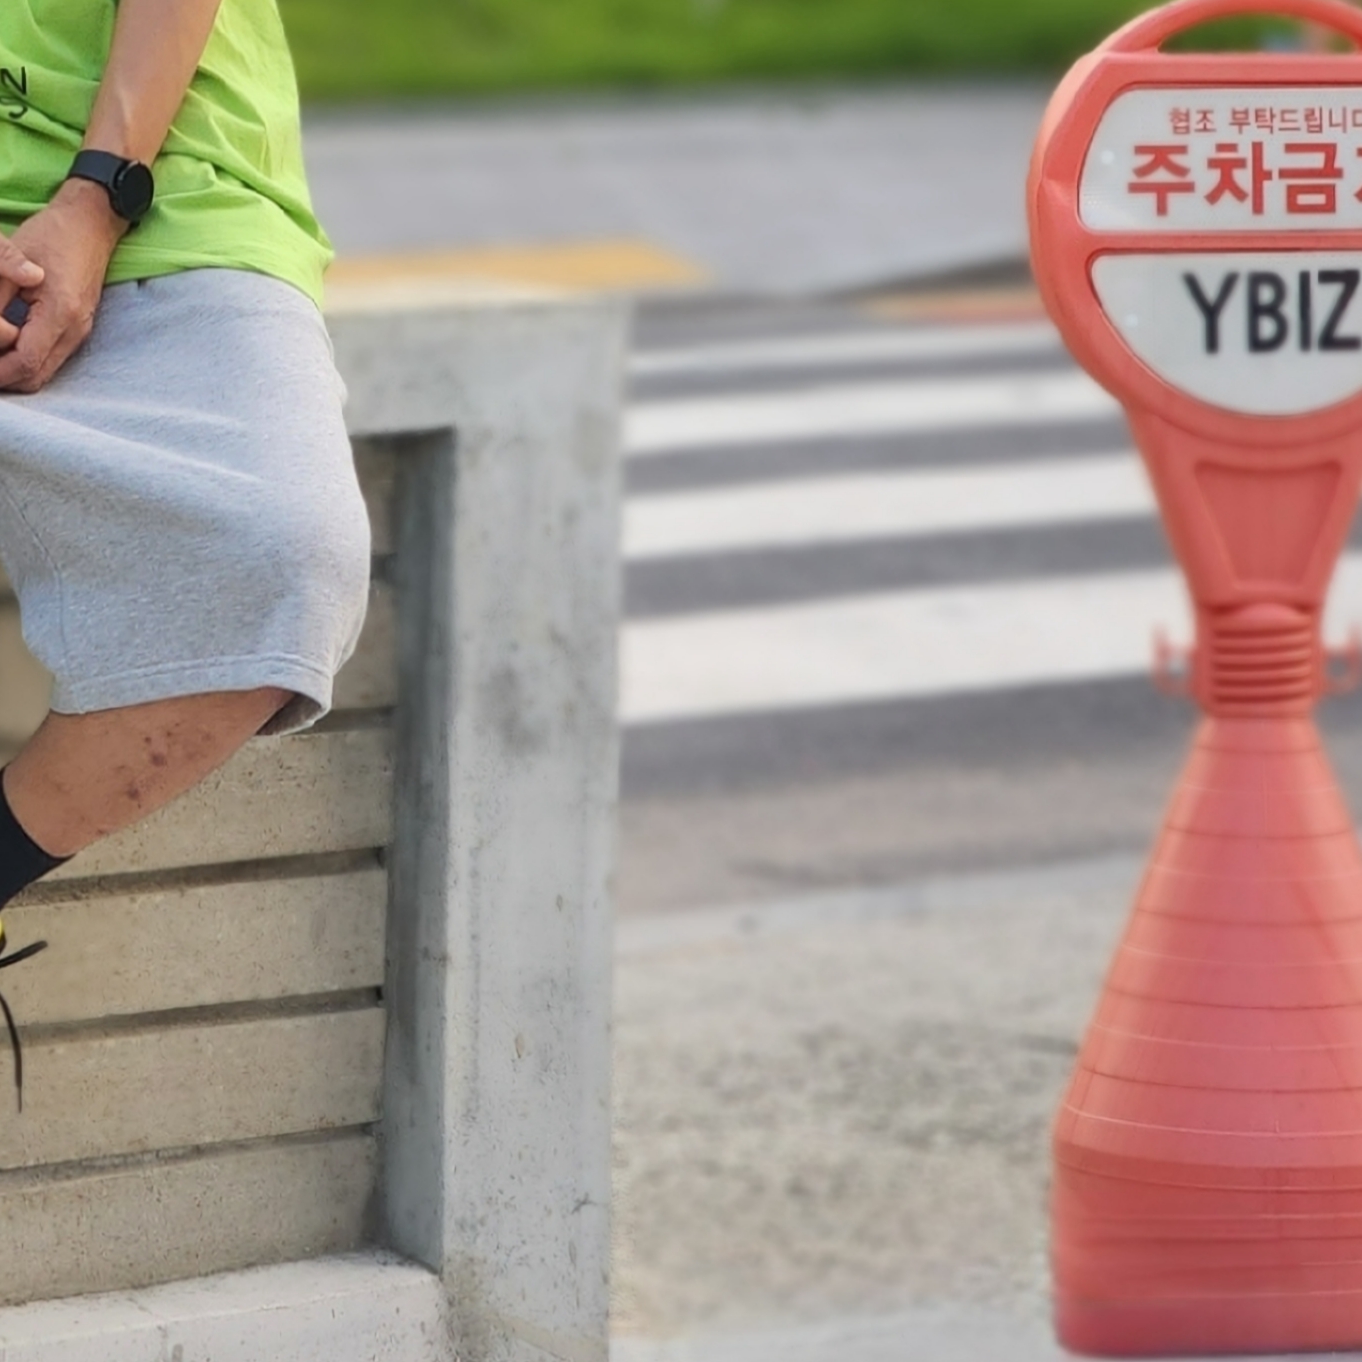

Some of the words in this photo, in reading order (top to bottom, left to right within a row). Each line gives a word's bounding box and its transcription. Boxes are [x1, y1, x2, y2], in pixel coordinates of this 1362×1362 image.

[1168, 106, 1217, 136] 협조
[1127, 141, 1362, 217] 주차금
[1183, 268, 1361, 355] YBIZ
